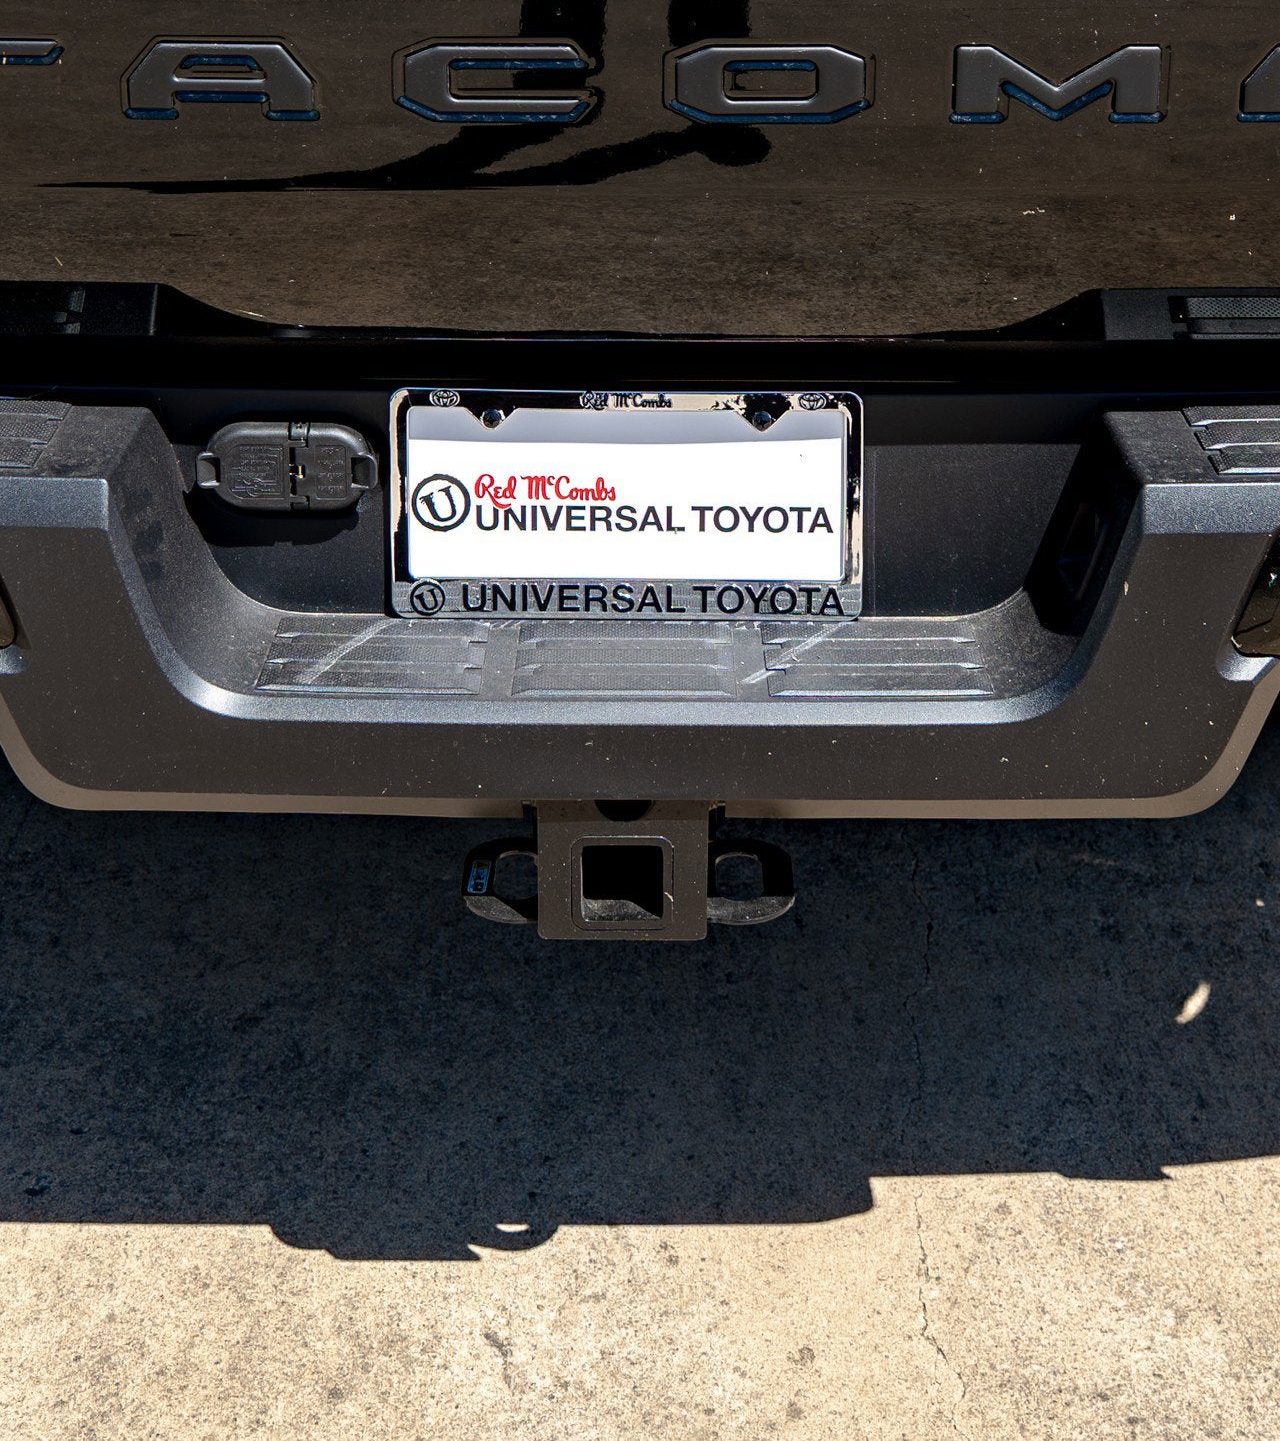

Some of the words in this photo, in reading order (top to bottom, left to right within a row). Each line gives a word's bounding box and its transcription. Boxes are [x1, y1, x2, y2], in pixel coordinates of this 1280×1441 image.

[579, 389, 609, 410] Red
[612, 392, 673, 409] McCombs
[474, 473, 518, 510] Red
[520, 474, 617, 502] McCombs
[475, 504, 686, 533] UNIVERSAL
[691, 505, 835, 534] TOYOTA
[462, 582, 687, 614] UNIVERSAL
[692, 583, 845, 616] TOYOTA
